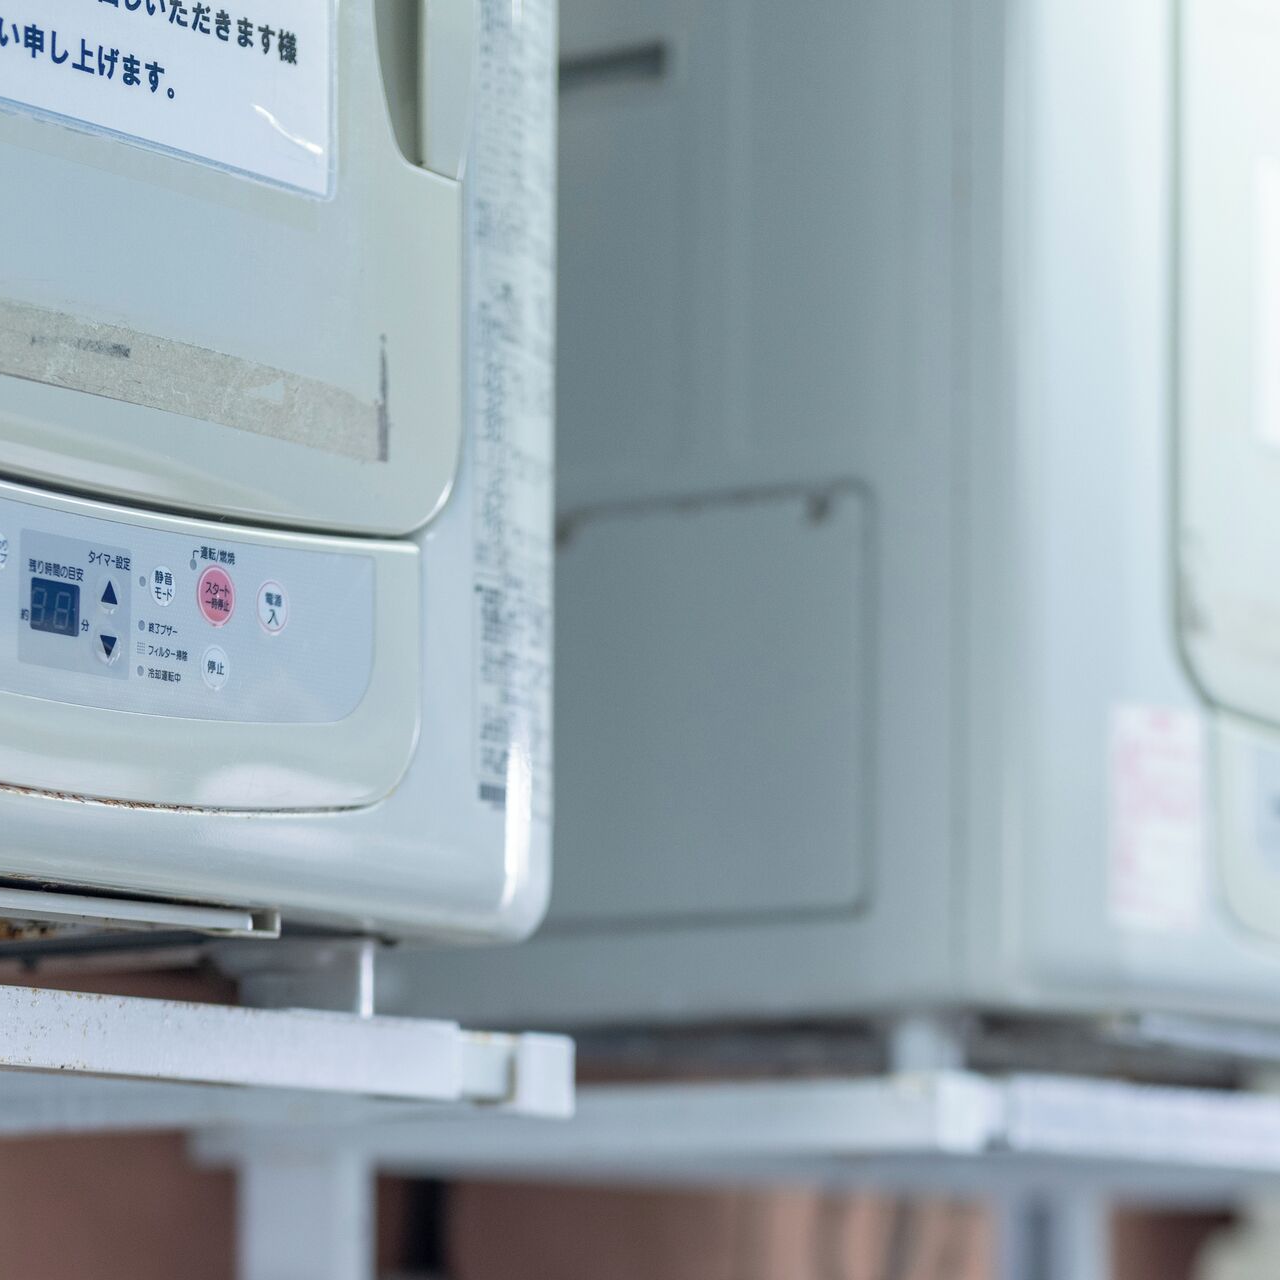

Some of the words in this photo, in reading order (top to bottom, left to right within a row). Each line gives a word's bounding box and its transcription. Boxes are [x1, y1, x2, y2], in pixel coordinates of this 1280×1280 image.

[98, 0, 298, 65] いただきます様
[88, 550, 131, 571] タイマー設定
[28, 558, 84, 582] 残り時間の目安
[155, 570, 173, 586] 静音
[155, 586, 173, 601] モード
[205, 582, 230, 597] スタート
[81, 619, 90, 632] 分
[267, 609, 280, 626] 入
[207, 660, 225, 675] 停止
